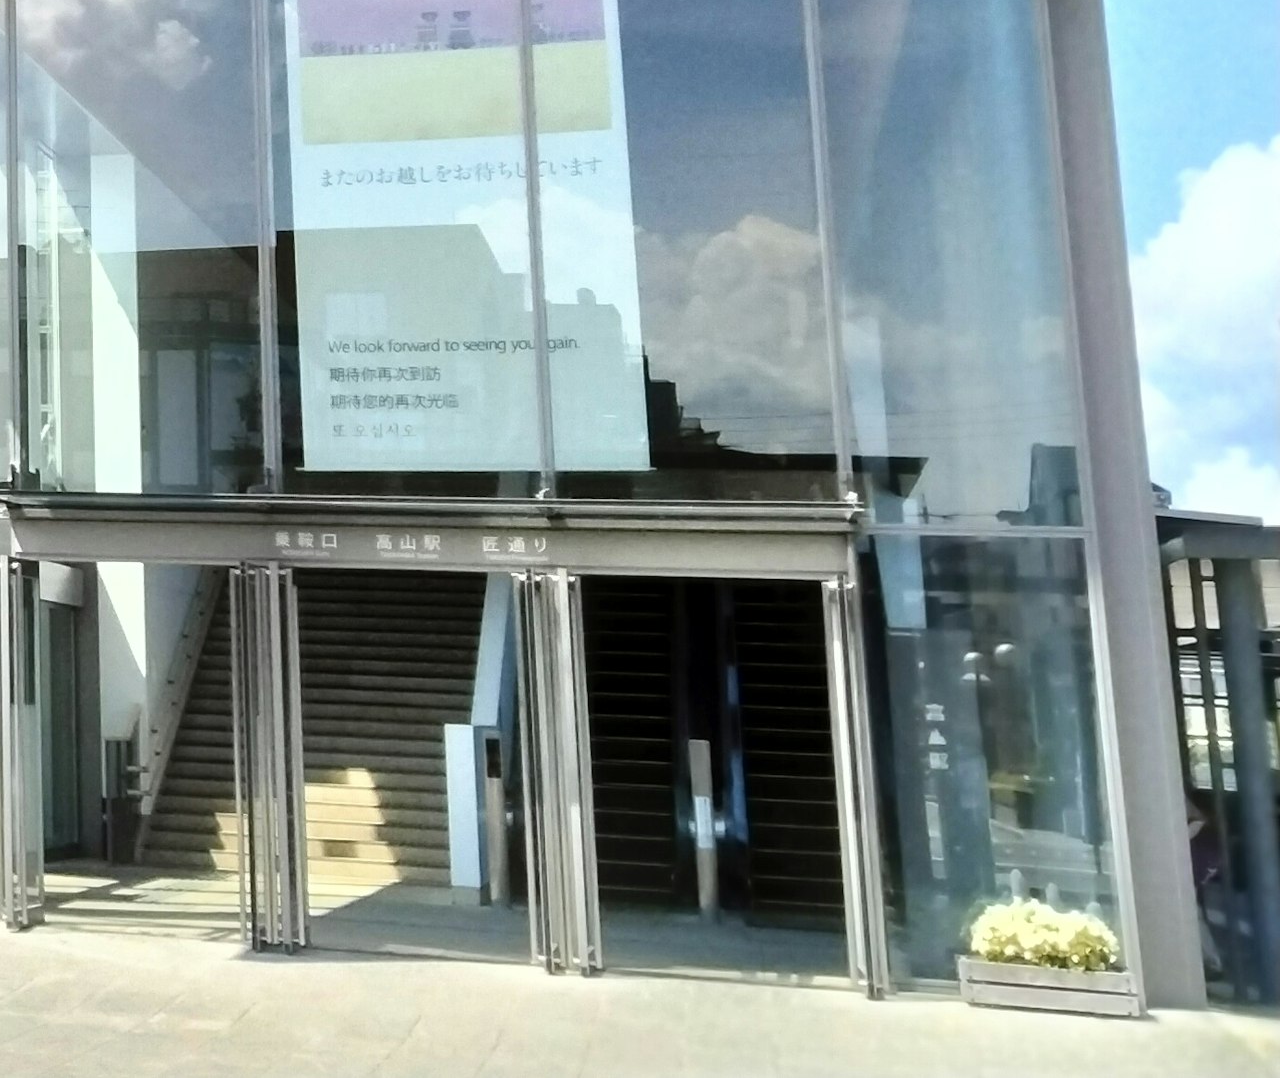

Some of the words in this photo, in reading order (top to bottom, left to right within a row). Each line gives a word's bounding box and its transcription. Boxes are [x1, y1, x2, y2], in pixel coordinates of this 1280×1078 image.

[328, 340, 351, 354] We
[354, 339, 385, 353] look
[388, 338, 441, 353] forward
[444, 340, 460, 352] to
[462, 338, 507, 354] seeing
[511, 339, 535, 354] you
[546, 336, 581, 353] gain.
[376, 533, 441, 551] 高山駅
